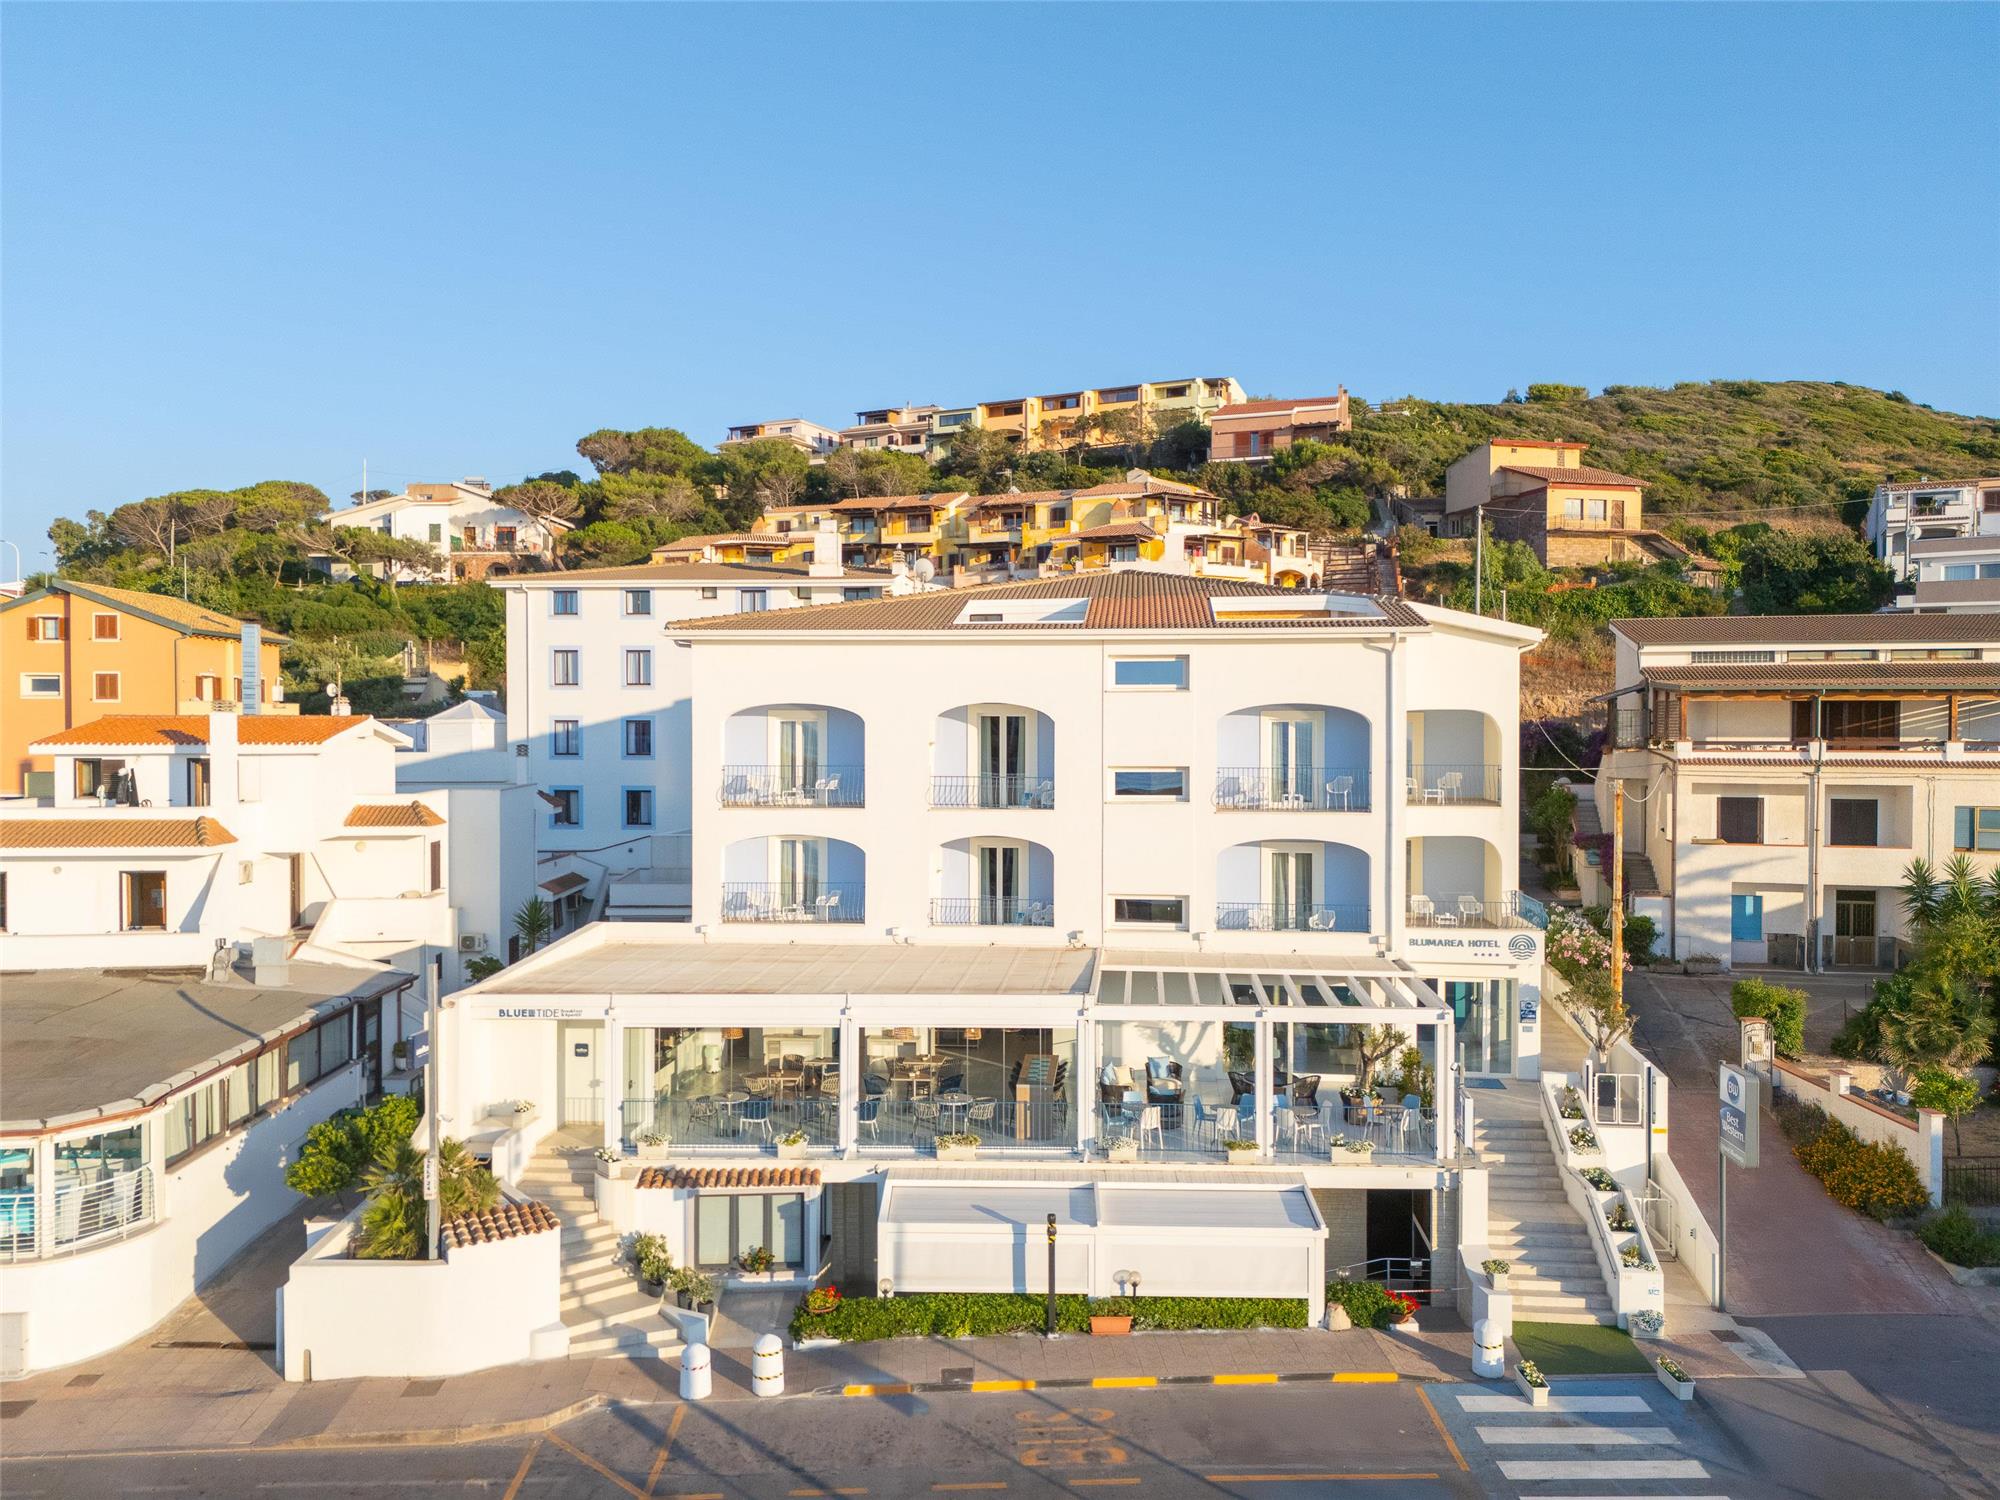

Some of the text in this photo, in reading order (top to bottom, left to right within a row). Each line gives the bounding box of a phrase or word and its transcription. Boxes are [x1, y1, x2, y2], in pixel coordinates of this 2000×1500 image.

[1409, 938, 1501, 948] BLUMAREA HOTEL
[499, 1009, 559, 1018] BLUE TIDE
[1726, 1112, 1739, 1128] Best
[1722, 1118, 1745, 1143] Western
